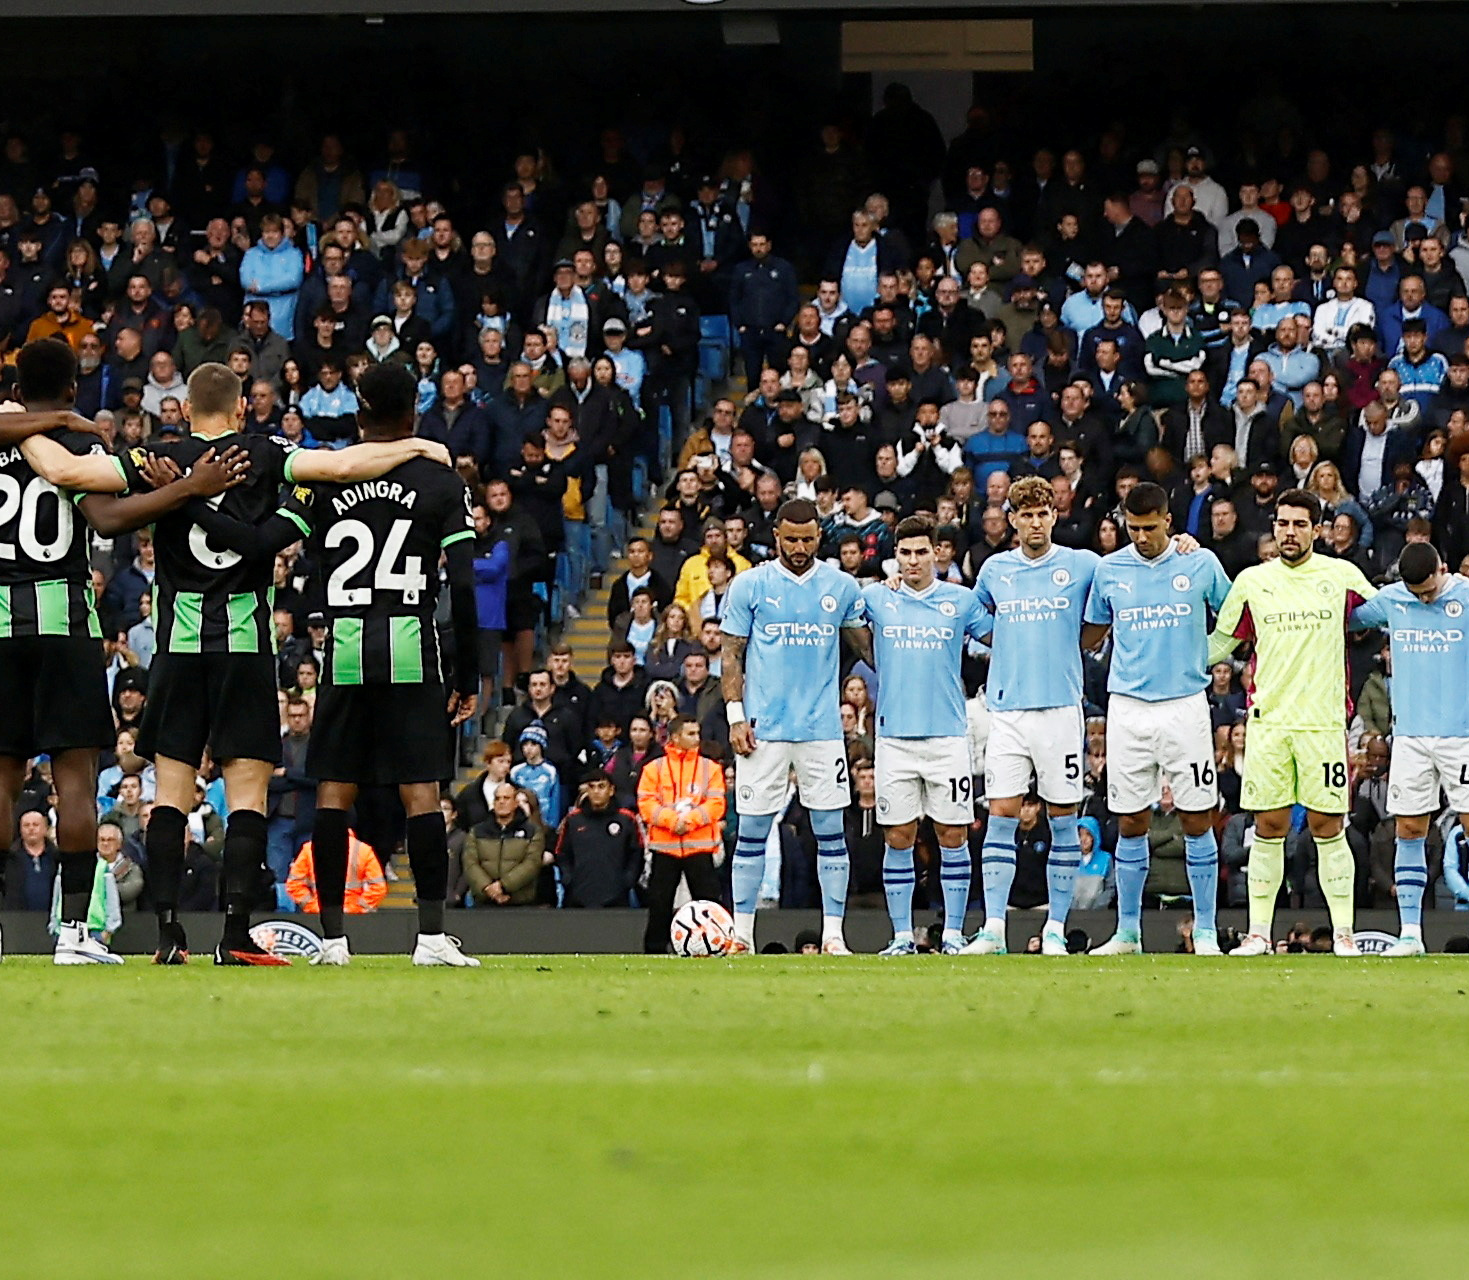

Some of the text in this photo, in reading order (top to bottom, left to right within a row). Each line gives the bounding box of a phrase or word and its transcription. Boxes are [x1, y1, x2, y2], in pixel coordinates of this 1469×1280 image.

[331, 480, 417, 515] ADINGRA
[325, 519, 427, 606] 24
[997, 596, 1070, 614] ETIHAD
[1118, 603, 1192, 621] ETIHAD
[1008, 612, 1057, 623] AIRWAYS
[1263, 609, 1332, 624] ETIHAD
[764, 622, 835, 636] ETIHAD
[882, 625, 954, 640] ETIHAD
[1130, 619, 1180, 632] AIRWAYS
[1276, 623, 1321, 633] AIRWAYS
[777, 637, 825, 647] AIRWAYS
[1393, 629, 1464, 642] ETIHAD
[893, 640, 943, 650] AIRWAYS
[1402, 644, 1450, 653] AIRWAYS
[835, 757, 847, 784] 2
[1065, 753, 1080, 780] 5
[1190, 760, 1214, 788] 16
[1322, 762, 1347, 788] 18
[949, 776, 971, 803] 19
